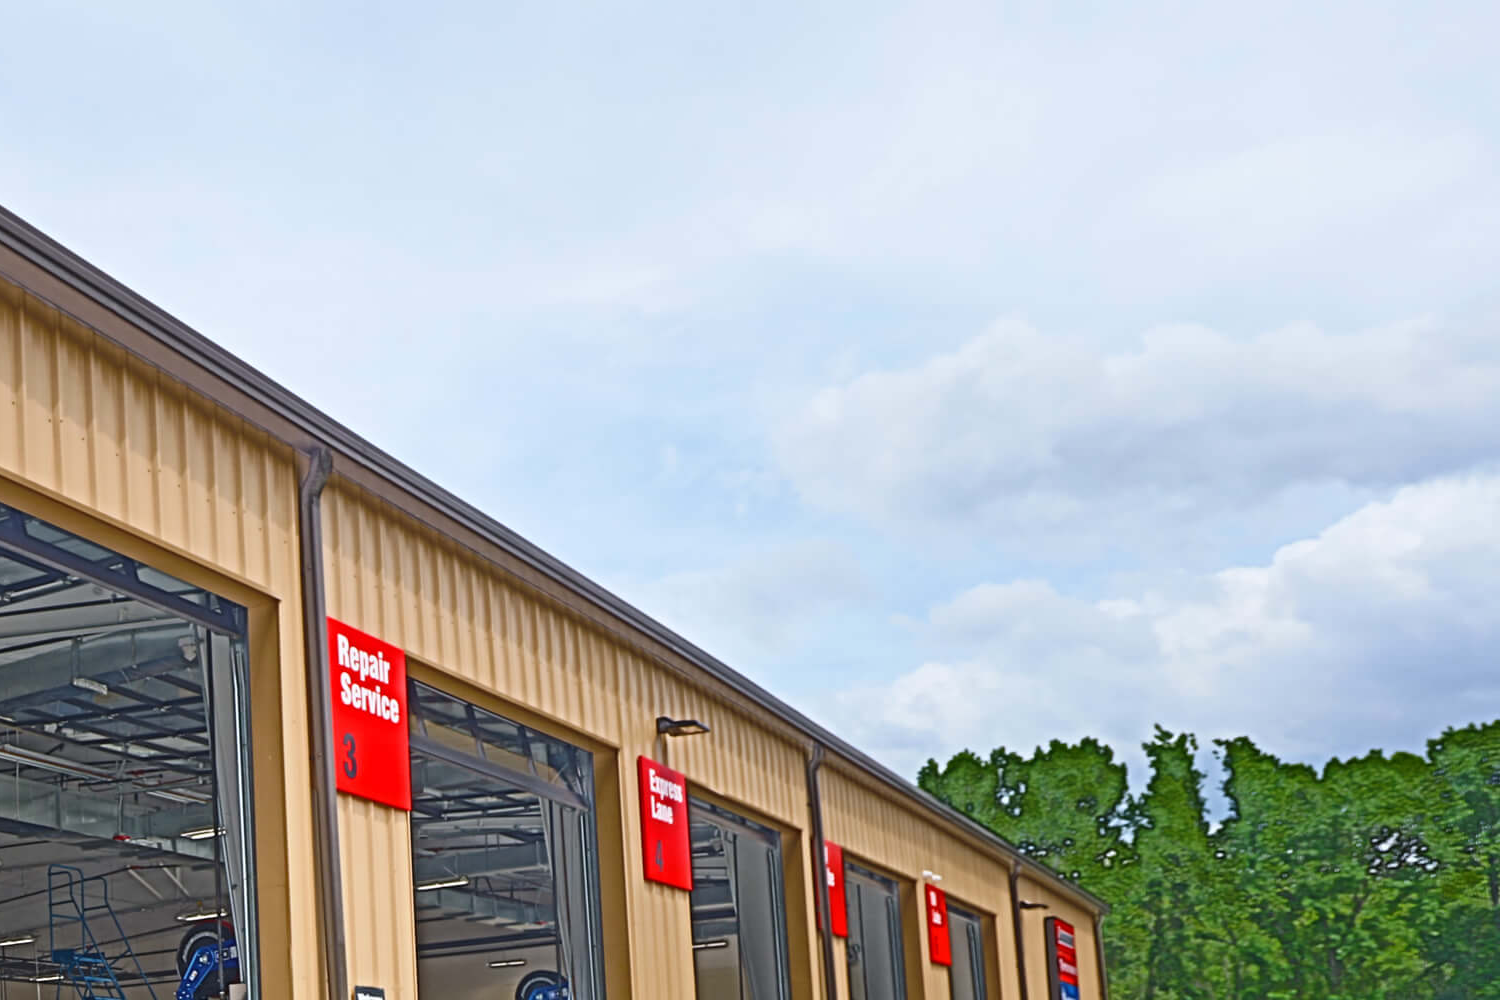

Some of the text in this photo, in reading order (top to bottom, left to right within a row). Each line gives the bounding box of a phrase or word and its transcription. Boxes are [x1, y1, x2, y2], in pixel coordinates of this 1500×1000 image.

[337, 633, 390, 685] Repair
[340, 671, 400, 724] Service
[343, 732, 357, 779] 3
[648, 768, 683, 803] Express
[650, 794, 673, 824] Lane
